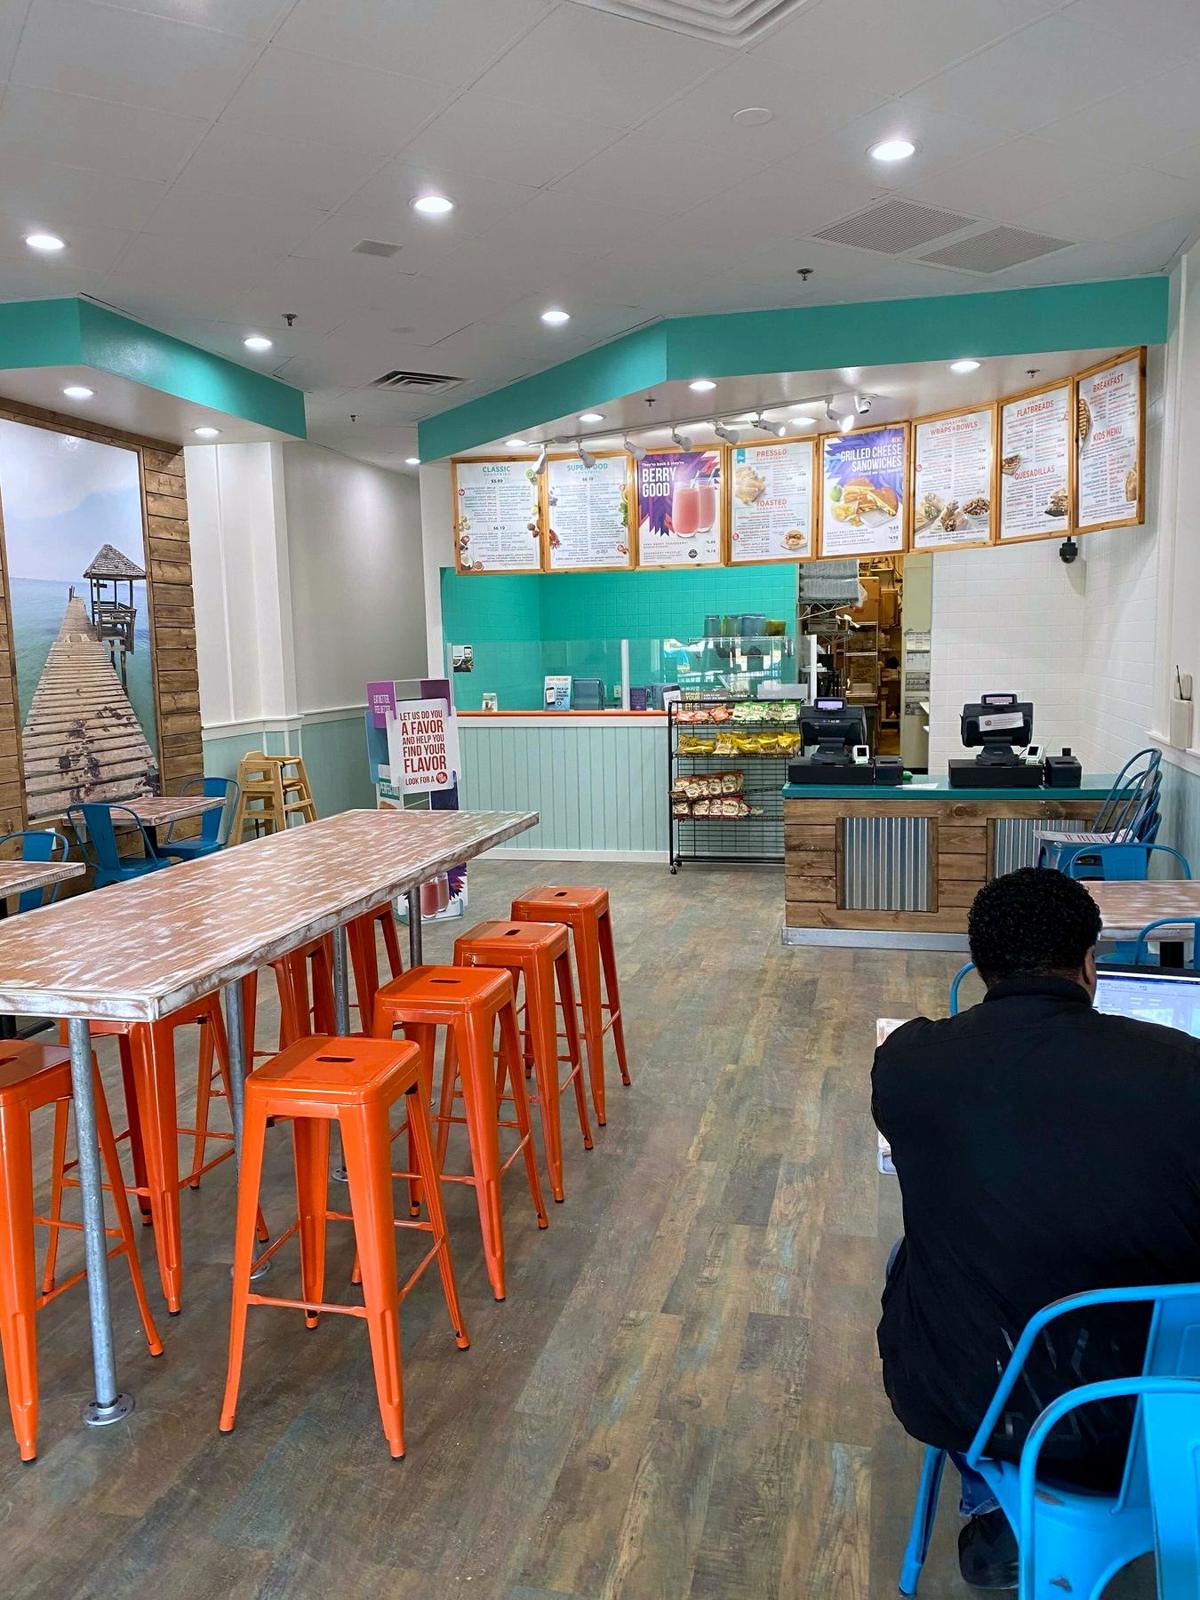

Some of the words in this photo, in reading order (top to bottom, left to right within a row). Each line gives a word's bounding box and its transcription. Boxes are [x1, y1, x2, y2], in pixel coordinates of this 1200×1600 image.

[1092, 373, 1124, 392] BREAKFAST
[1016, 400, 1055, 417] FLATBREADS
[930, 426, 952, 436] WRAPS
[956, 421, 978, 431] BOWLS
[1092, 429, 1106, 442] KIDS
[1106, 424, 1123, 438] MENU
[756, 448, 787, 457] PRESSED
[840, 447, 871, 462] GRILLED
[872, 444, 902, 458] CHEESE
[567, 463, 608, 471] SUPEOOD
[852, 456, 902, 472] SANDWICHES
[642, 466, 677, 482] BERRY
[1014, 465, 1056, 480] QUESADILLAS
[642, 482, 670, 498] GOOD
[756, 498, 787, 507] TOASTED
[400, 712, 411, 721] LET
[421, 711, 430, 719] DO
[431, 710, 442, 718] YOU
[401, 722, 408, 736] A
[411, 720, 444, 735] FAVOR
[402, 736, 415, 745] AND
[416, 735, 432, 744] HELP
[433, 734, 444, 742] YOU
[403, 746, 422, 758] FIND
[424, 743, 446, 756] YOUR
[404, 756, 447, 774] FLAVOR
[405, 777, 419, 786] LOOK
[420, 776, 430, 784] FOR
